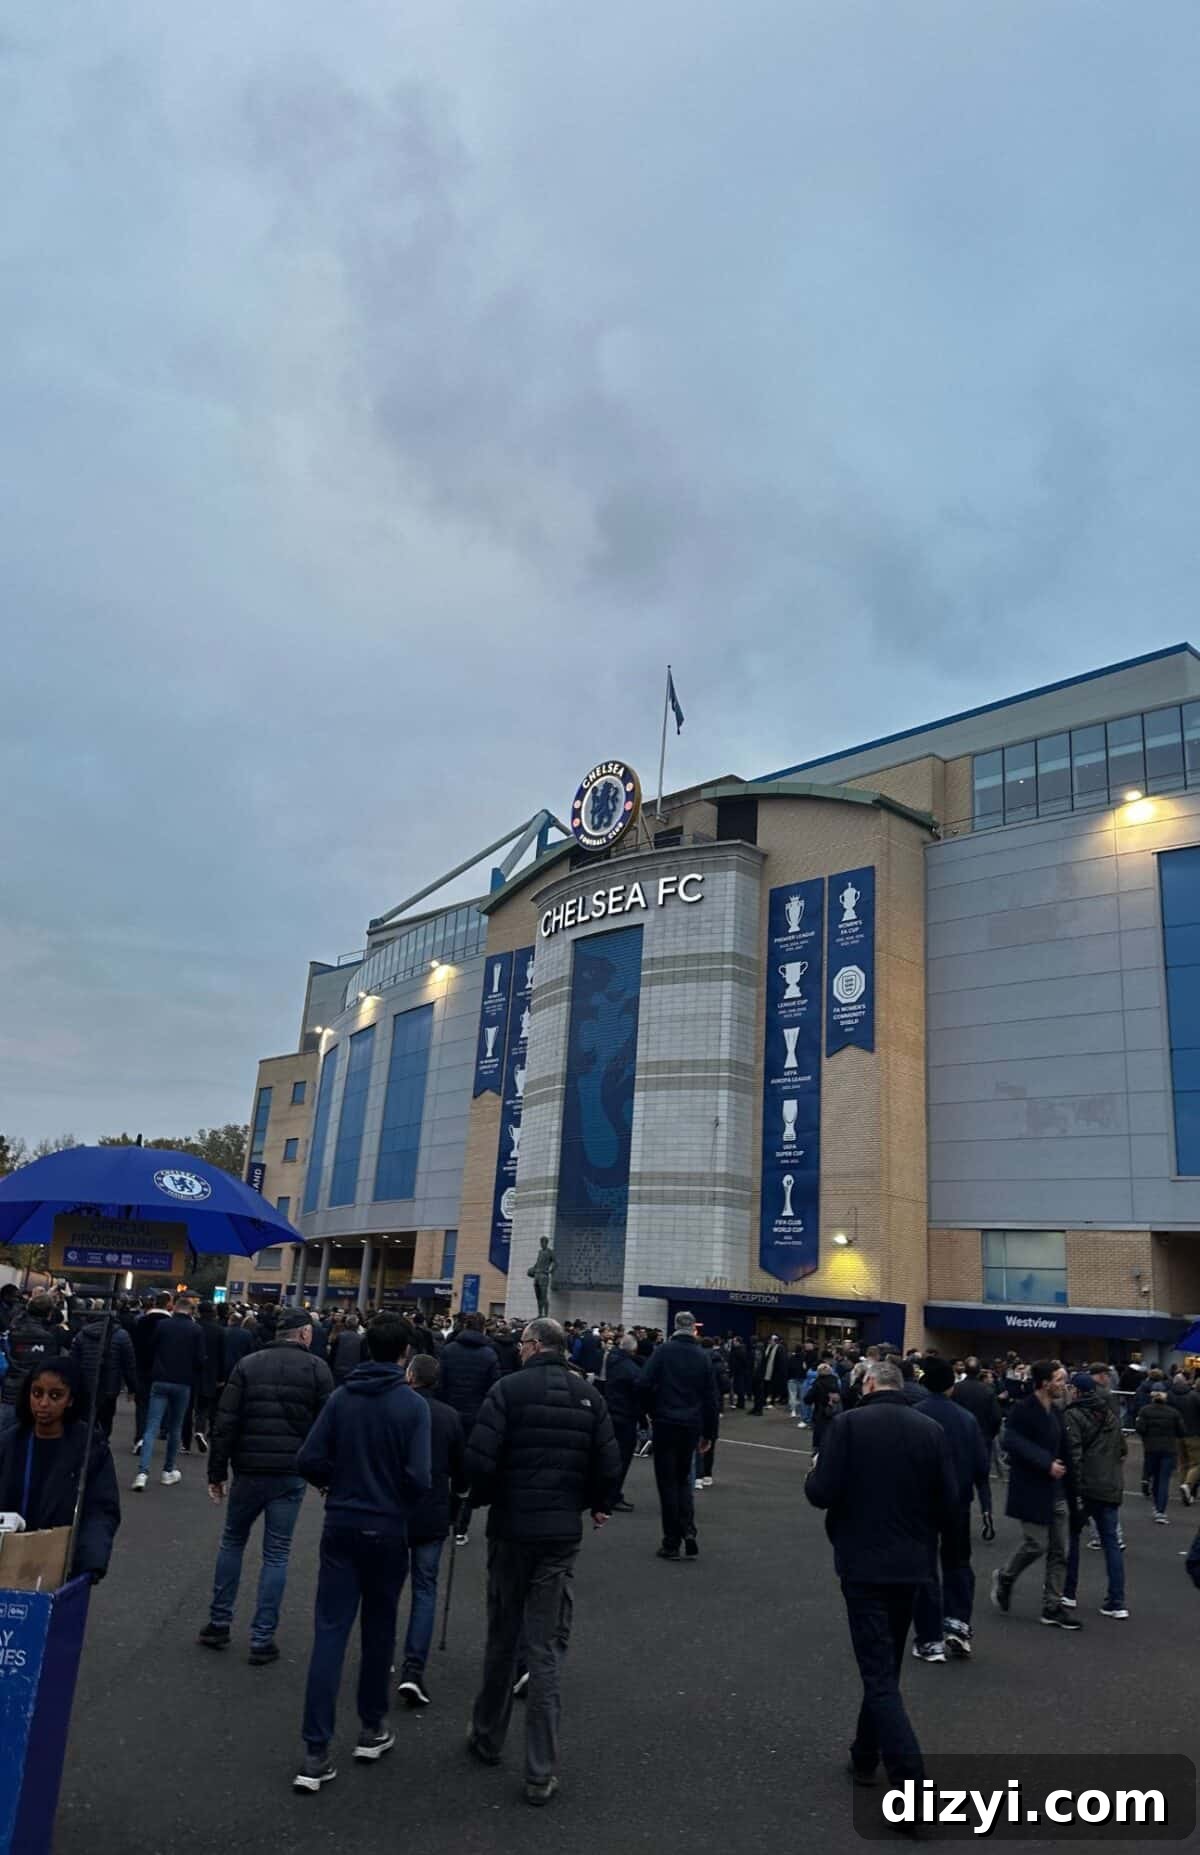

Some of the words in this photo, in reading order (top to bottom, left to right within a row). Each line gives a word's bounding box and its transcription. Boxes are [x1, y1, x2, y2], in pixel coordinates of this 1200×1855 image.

[582, 763, 625, 789] CHELSEA
[607, 821, 624, 839] CLUB
[541, 881, 647, 938] CHELSEA
[657, 873, 705, 906] FC
[251, 1168, 263, 1193] AND
[729, 1293, 779, 1304] RECEPTION
[1005, 1315, 1057, 1329] Westview
